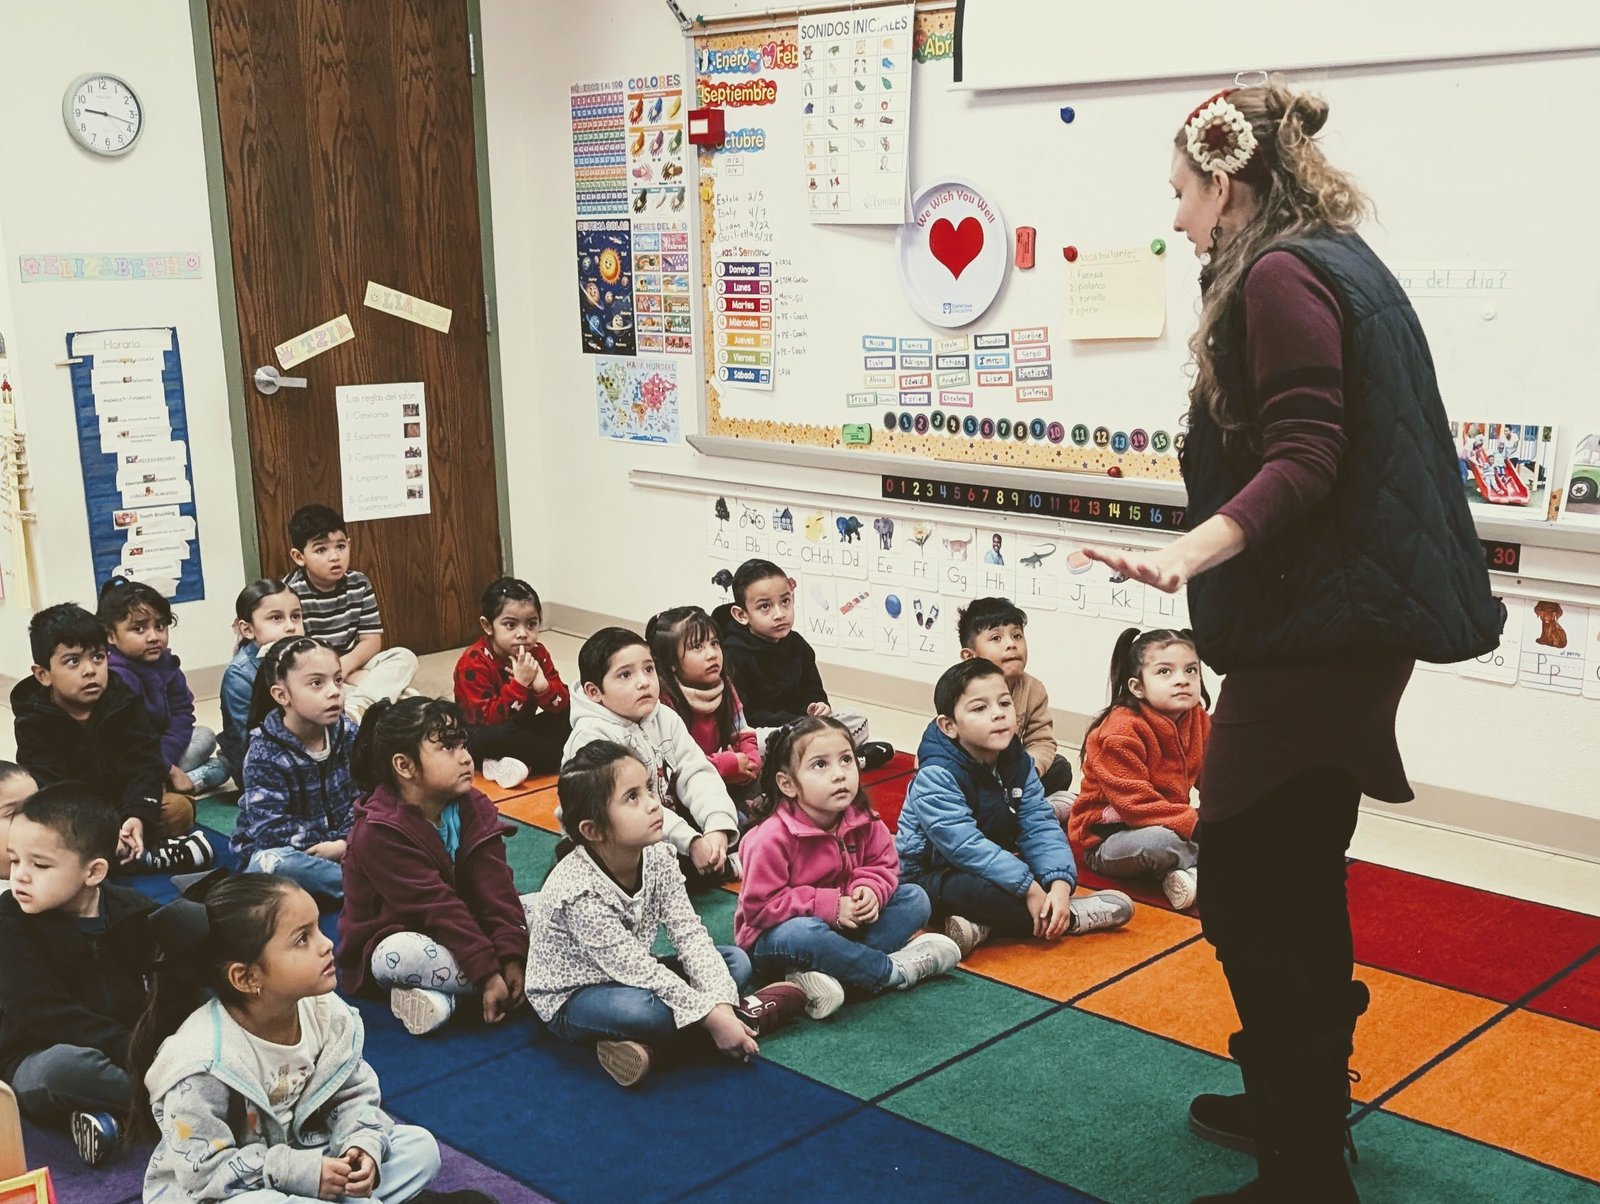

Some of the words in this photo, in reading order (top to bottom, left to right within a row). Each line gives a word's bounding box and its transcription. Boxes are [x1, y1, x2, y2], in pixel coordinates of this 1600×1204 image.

[801, 21, 850, 40] SONIDOS
[716, 52, 749, 68] Enero
[88, 84, 93, 93] 11
[98, 81, 107, 90] 12
[115, 85, 118, 94] 1
[628, 74, 681, 90] COLORES
[78, 95, 86, 104] 10
[124, 96, 129, 104] 2
[703, 84, 775, 104] Septiembre
[76, 108, 81, 117] 9
[129, 110, 135, 119] 3
[81, 123, 86, 132] 8
[92, 133, 97, 142] 7
[105, 138, 110, 146] 6
[118, 134, 123, 143] 5
[748, 190, 764, 202] 2/5
[748, 206, 767, 220] 4/7
[917, 210, 932, 227] We
[930, 190, 954, 211] Wish
[956, 190, 975, 204] You
[977, 198, 996, 223] Well
[577, 222, 606, 232] SISTEMA
[606, 221, 630, 232] SOLAR
[672, 222, 687, 232] AO
[729, 264, 755, 276] Domingo
[734, 283, 752, 292] Lunes
[1426, 270, 1450, 289] del
[732, 300, 755, 310] Martes
[729, 318, 759, 328] Miércoles
[104, 340, 140, 350] Horario
[734, 336, 754, 345] Jueves
[733, 353, 756, 362] Viernes
[734, 370, 755, 380] Sábado
[387, 392, 396, 401] del
[903, 417, 909, 428] 1
[918, 418, 924, 429] 2
[935, 414, 941, 426] 3
[950, 419, 956, 431] 4
[968, 420, 974, 431] 5
[984, 422, 990, 434] 6
[1001, 423, 1007, 434] 7
[1017, 425, 1023, 437] 8
[1035, 424, 1041, 435] 9
[1050, 427, 1061, 439] 10
[1075, 430, 1085, 440] 11
[1097, 431, 1107, 443] 12
[1114, 437, 1125, 448] 13
[1134, 434, 1144, 446] 14
[1155, 436, 1166, 448] 15
[886, 479, 894, 492] 0
[901, 480, 905, 493] 1
[913, 482, 920, 496] 2
[926, 483, 933, 496] 3
[940, 485, 946, 498] 4
[954, 486, 961, 499] 5
[968, 488, 975, 501] 6
[982, 489, 989, 502] 7
[996, 490, 1004, 504] 8
[1011, 492, 1019, 506] 9
[1029, 494, 1042, 508] 10
[1051, 497, 1060, 510] 11
[1069, 498, 1080, 513] 12
[1088, 500, 1100, 515] 13
[1109, 502, 1120, 518] 14
[1129, 505, 1141, 520] 15
[1150, 508, 1162, 523] 16
[1172, 511, 1184, 526] 17
[714, 532, 729, 549] Aa
[746, 536, 760, 552] Bb
[776, 540, 792, 557] Cc
[801, 546, 833, 564] CHch
[842, 549, 859, 566] Dd
[1494, 548, 1516, 566] 30
[878, 556, 893, 573] Ee
[914, 560, 928, 578] Ff
[948, 566, 967, 592] Gg
[986, 572, 1004, 590] Hh
[1032, 578, 1041, 596] Ii
[1070, 583, 1086, 610] Jj
[1112, 588, 1132, 608] Kk
[1159, 596, 1175, 616] Ll
[809, 617, 834, 635] Ww
[848, 621, 864, 638] Xx
[884, 627, 898, 650] Yy
[920, 635, 935, 652] Zz
[1538, 654, 1560, 685] Pp
